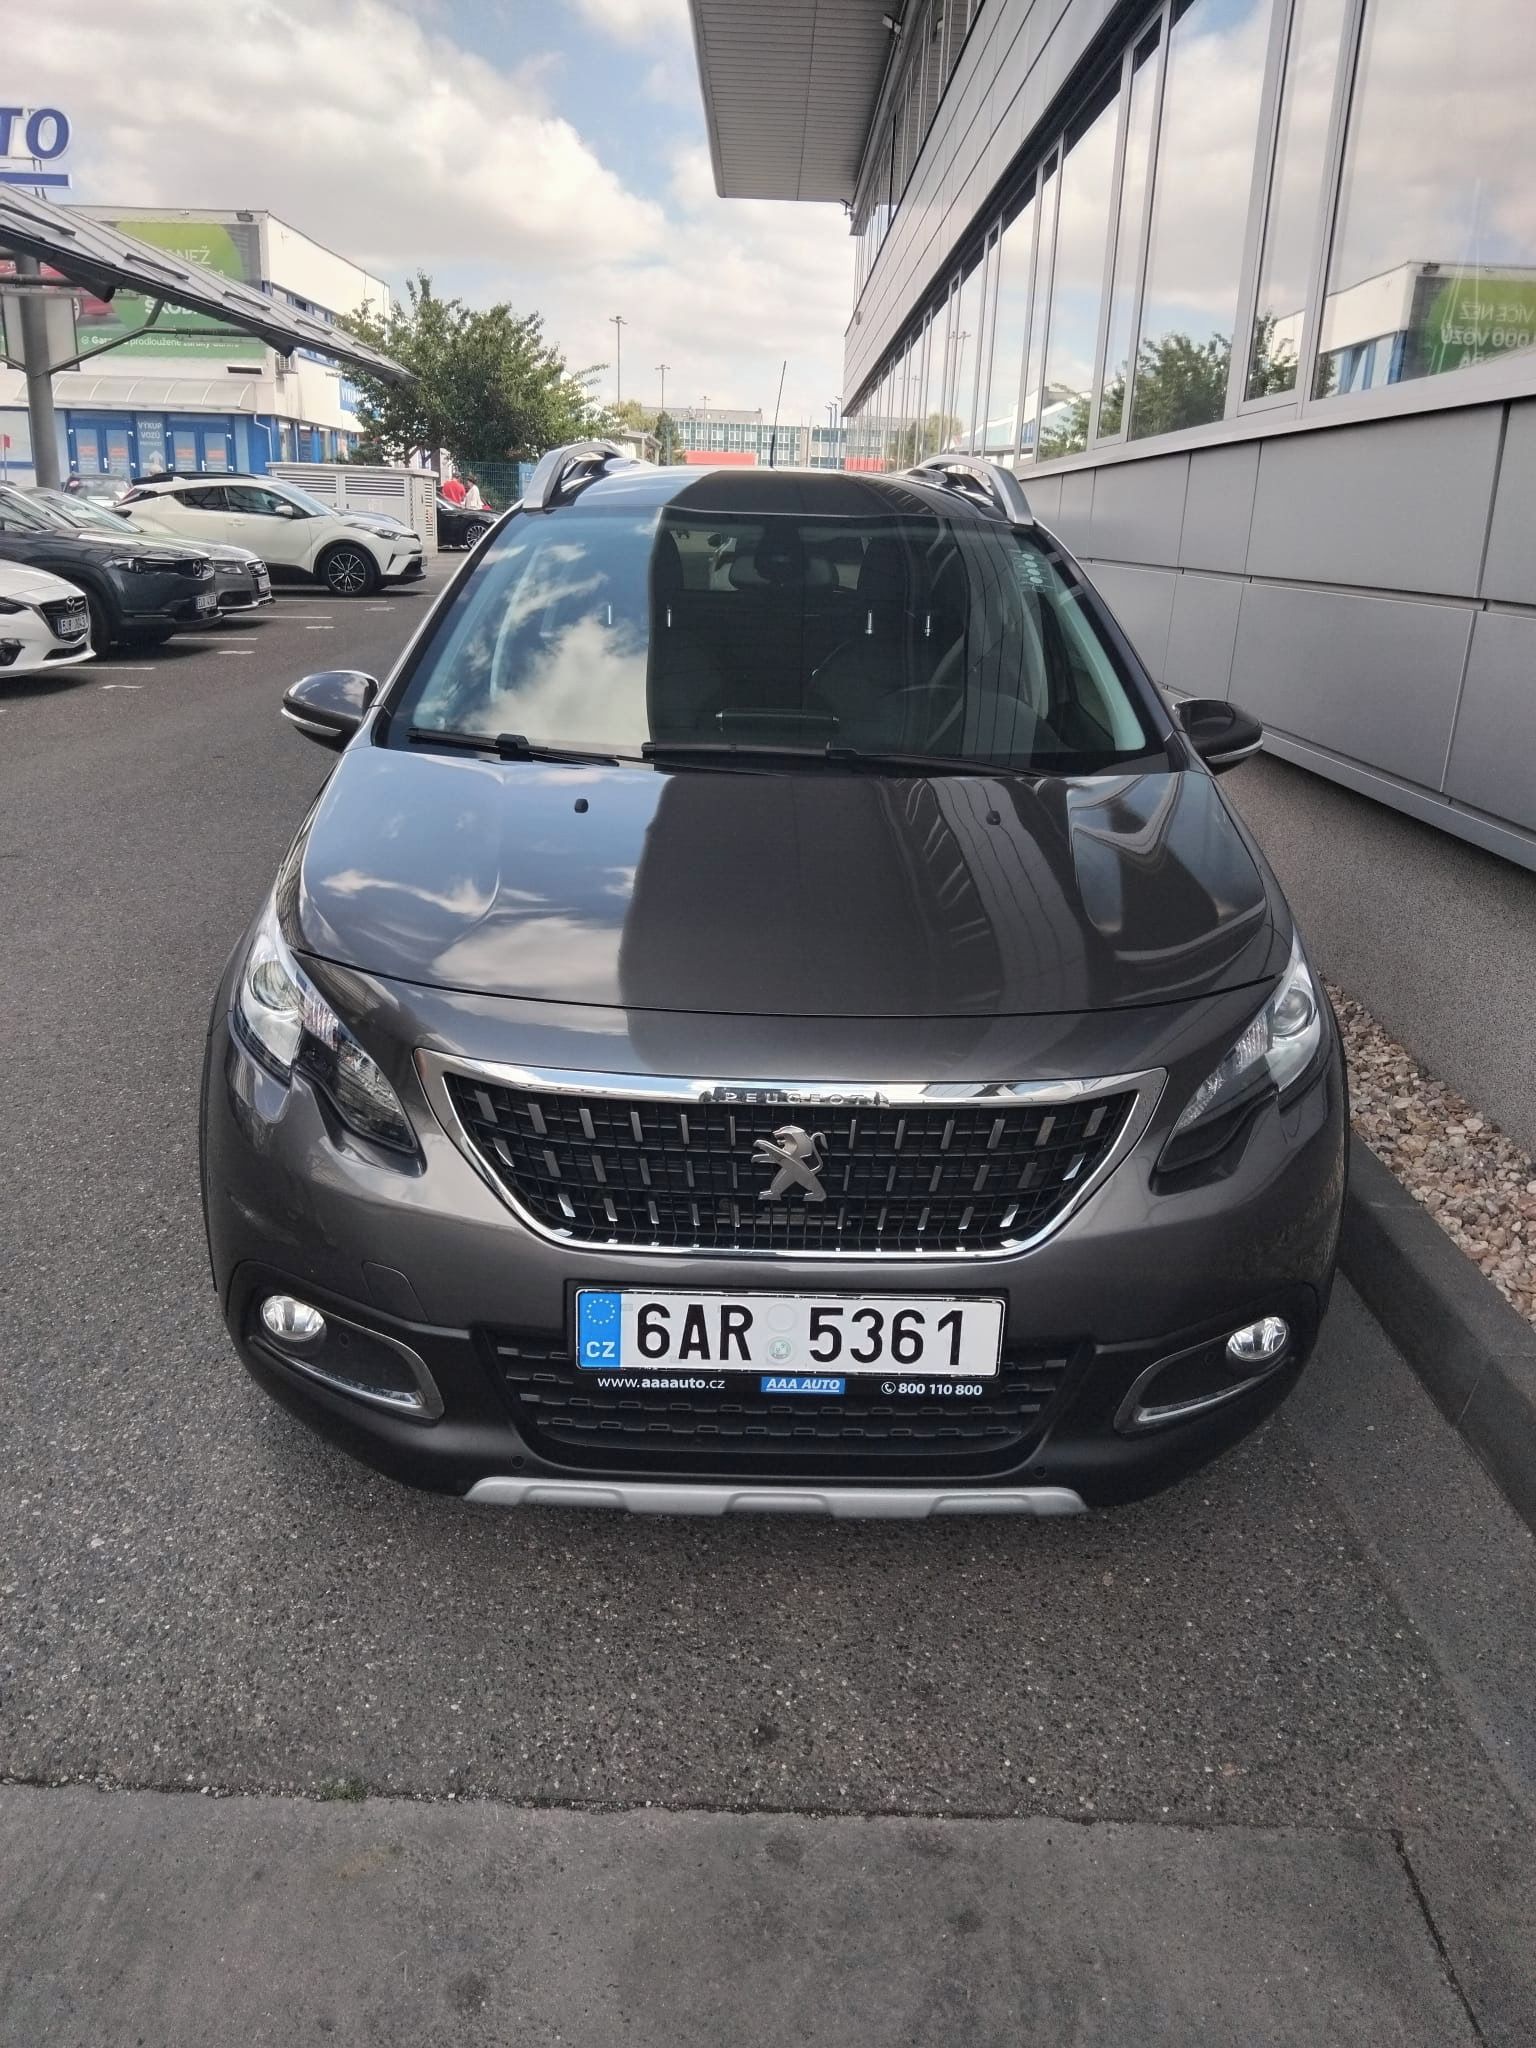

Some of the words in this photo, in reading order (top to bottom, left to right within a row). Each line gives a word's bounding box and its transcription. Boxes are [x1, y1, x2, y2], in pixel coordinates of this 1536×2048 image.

[724, 1091, 865, 1106] PEUGEOT
[637, 1303, 754, 1361] 6AR
[809, 1307, 963, 1366] 5361
[586, 1341, 616, 1358] CZ
[597, 1376, 726, 1390] www.aaaauto.cz
[766, 1379, 798, 1389] AAA
[801, 1379, 840, 1390] AUTO
[898, 1382, 925, 1395] 800
[929, 1383, 951, 1395] 110
[954, 1384, 983, 1396] 800
